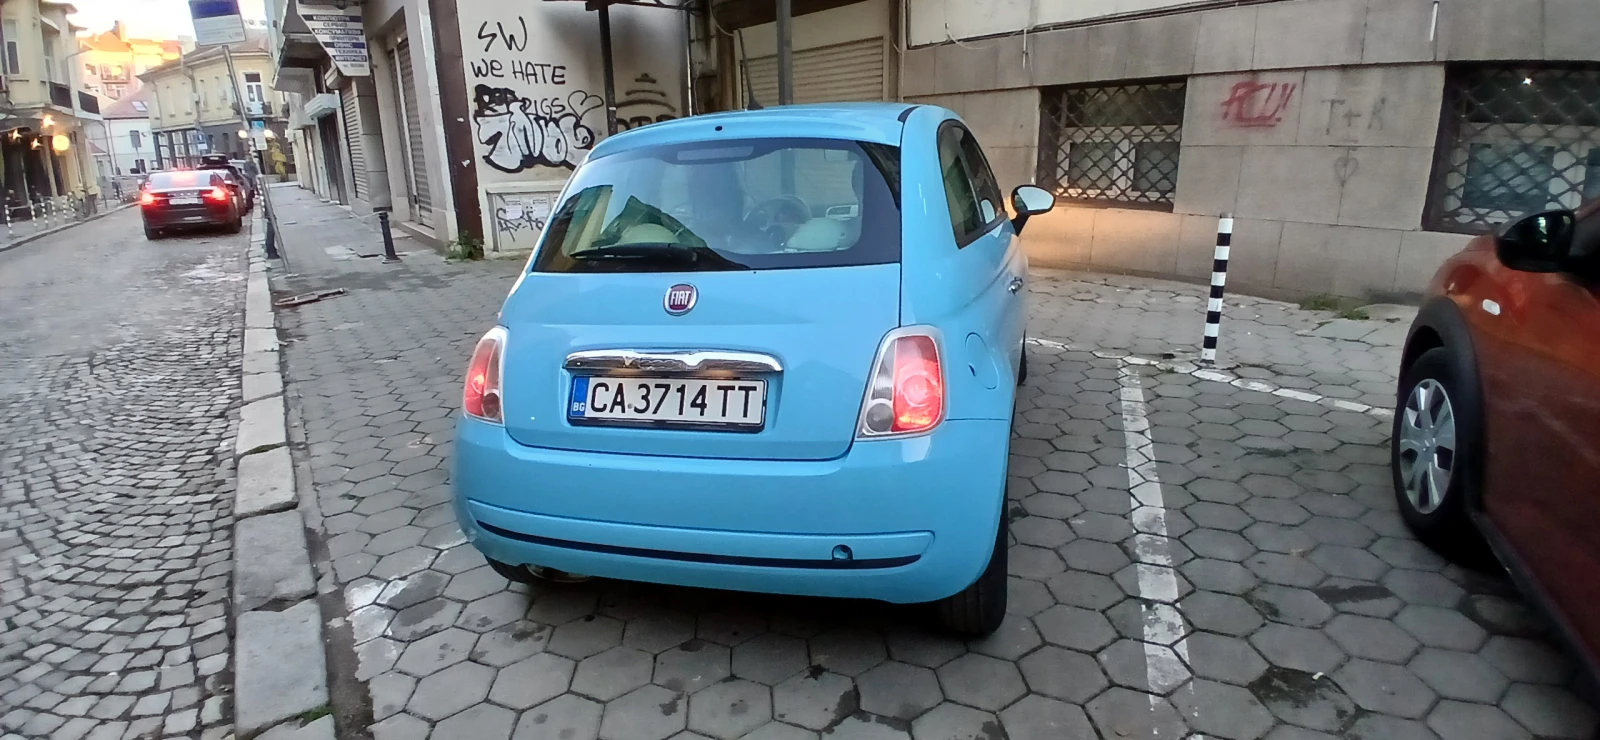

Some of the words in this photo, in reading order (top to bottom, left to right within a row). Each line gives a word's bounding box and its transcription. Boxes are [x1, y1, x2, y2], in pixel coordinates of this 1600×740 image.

[511, 60, 567, 85] HATE
[669, 290, 692, 306] FIAT
[572, 401, 586, 412] BG
